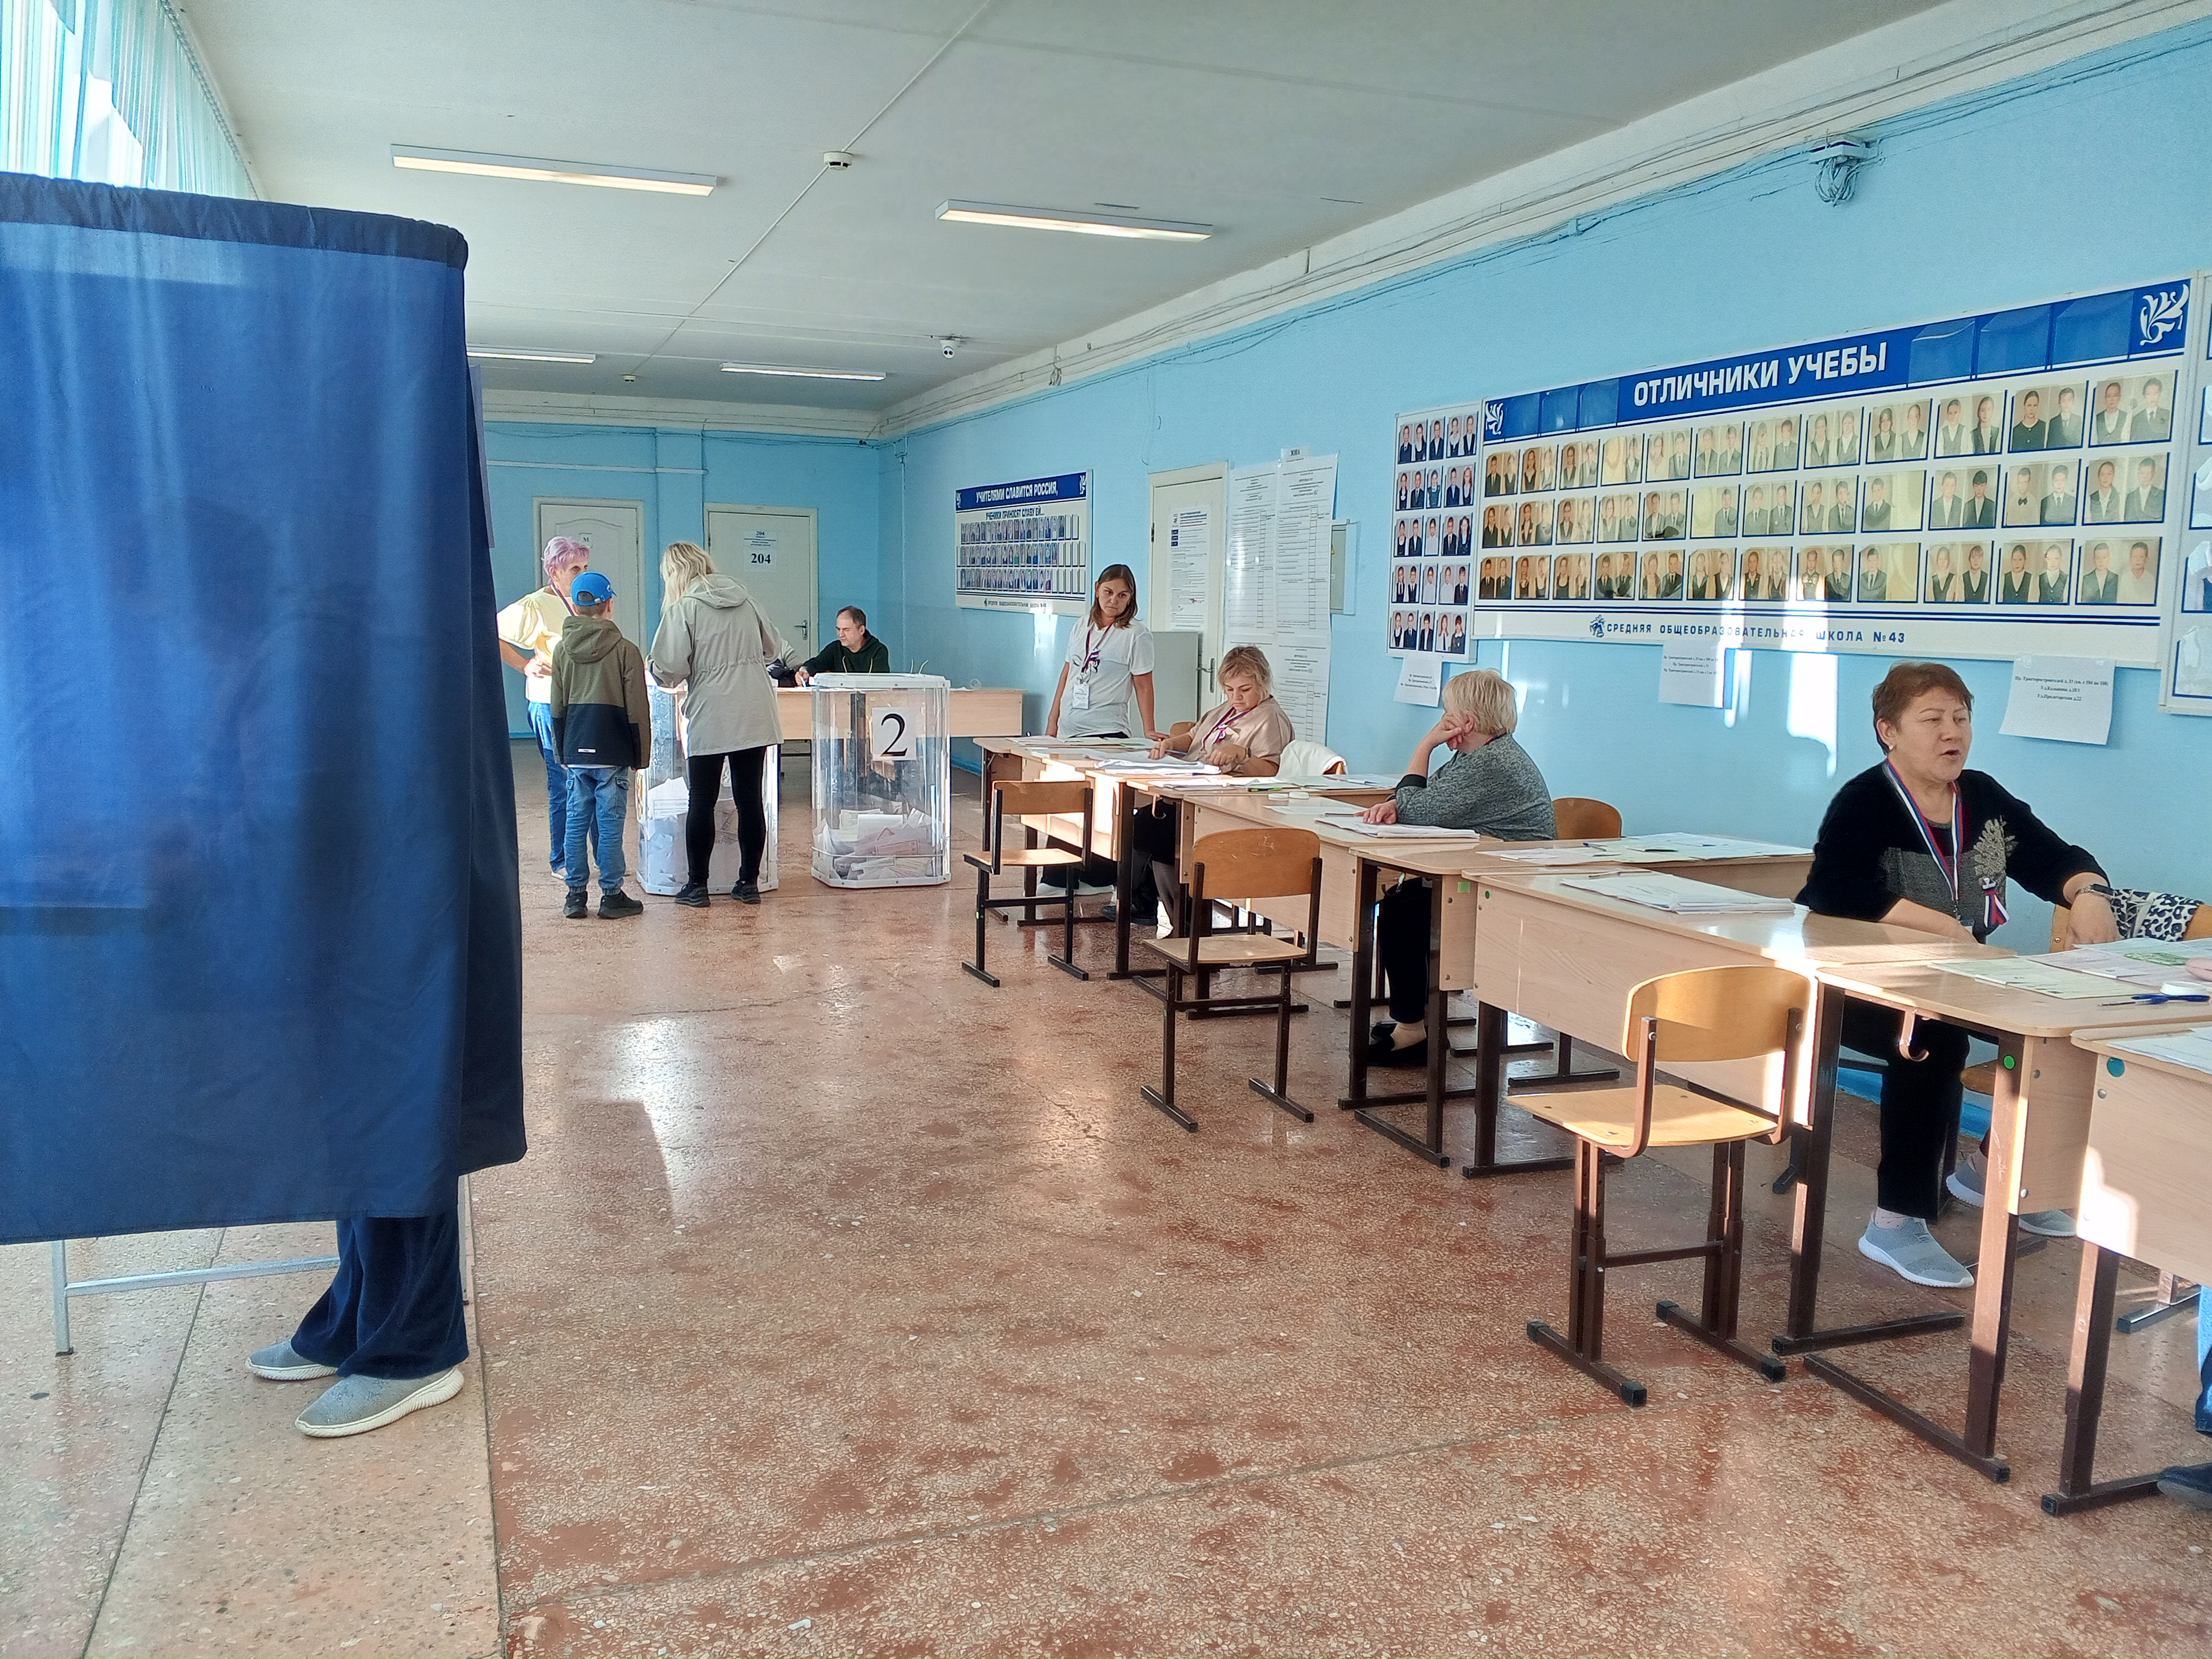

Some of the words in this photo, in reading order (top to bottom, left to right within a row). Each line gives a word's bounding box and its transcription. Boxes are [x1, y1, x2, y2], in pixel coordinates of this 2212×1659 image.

[1633, 359, 1779, 407] ОТЛИЧНИКИ
[1787, 341, 1888, 385] УЧЕБЫ
[976, 488, 1005, 503] УЧИТЕЛЯМИ
[1005, 484, 1033, 500] СЛАВИТСЯ
[751, 553, 771, 564] 204
[1607, 623, 1651, 634] СРЕДНЯЯ
[1816, 630, 1863, 642] ШКОЛА
[880, 713, 908, 757] 2
